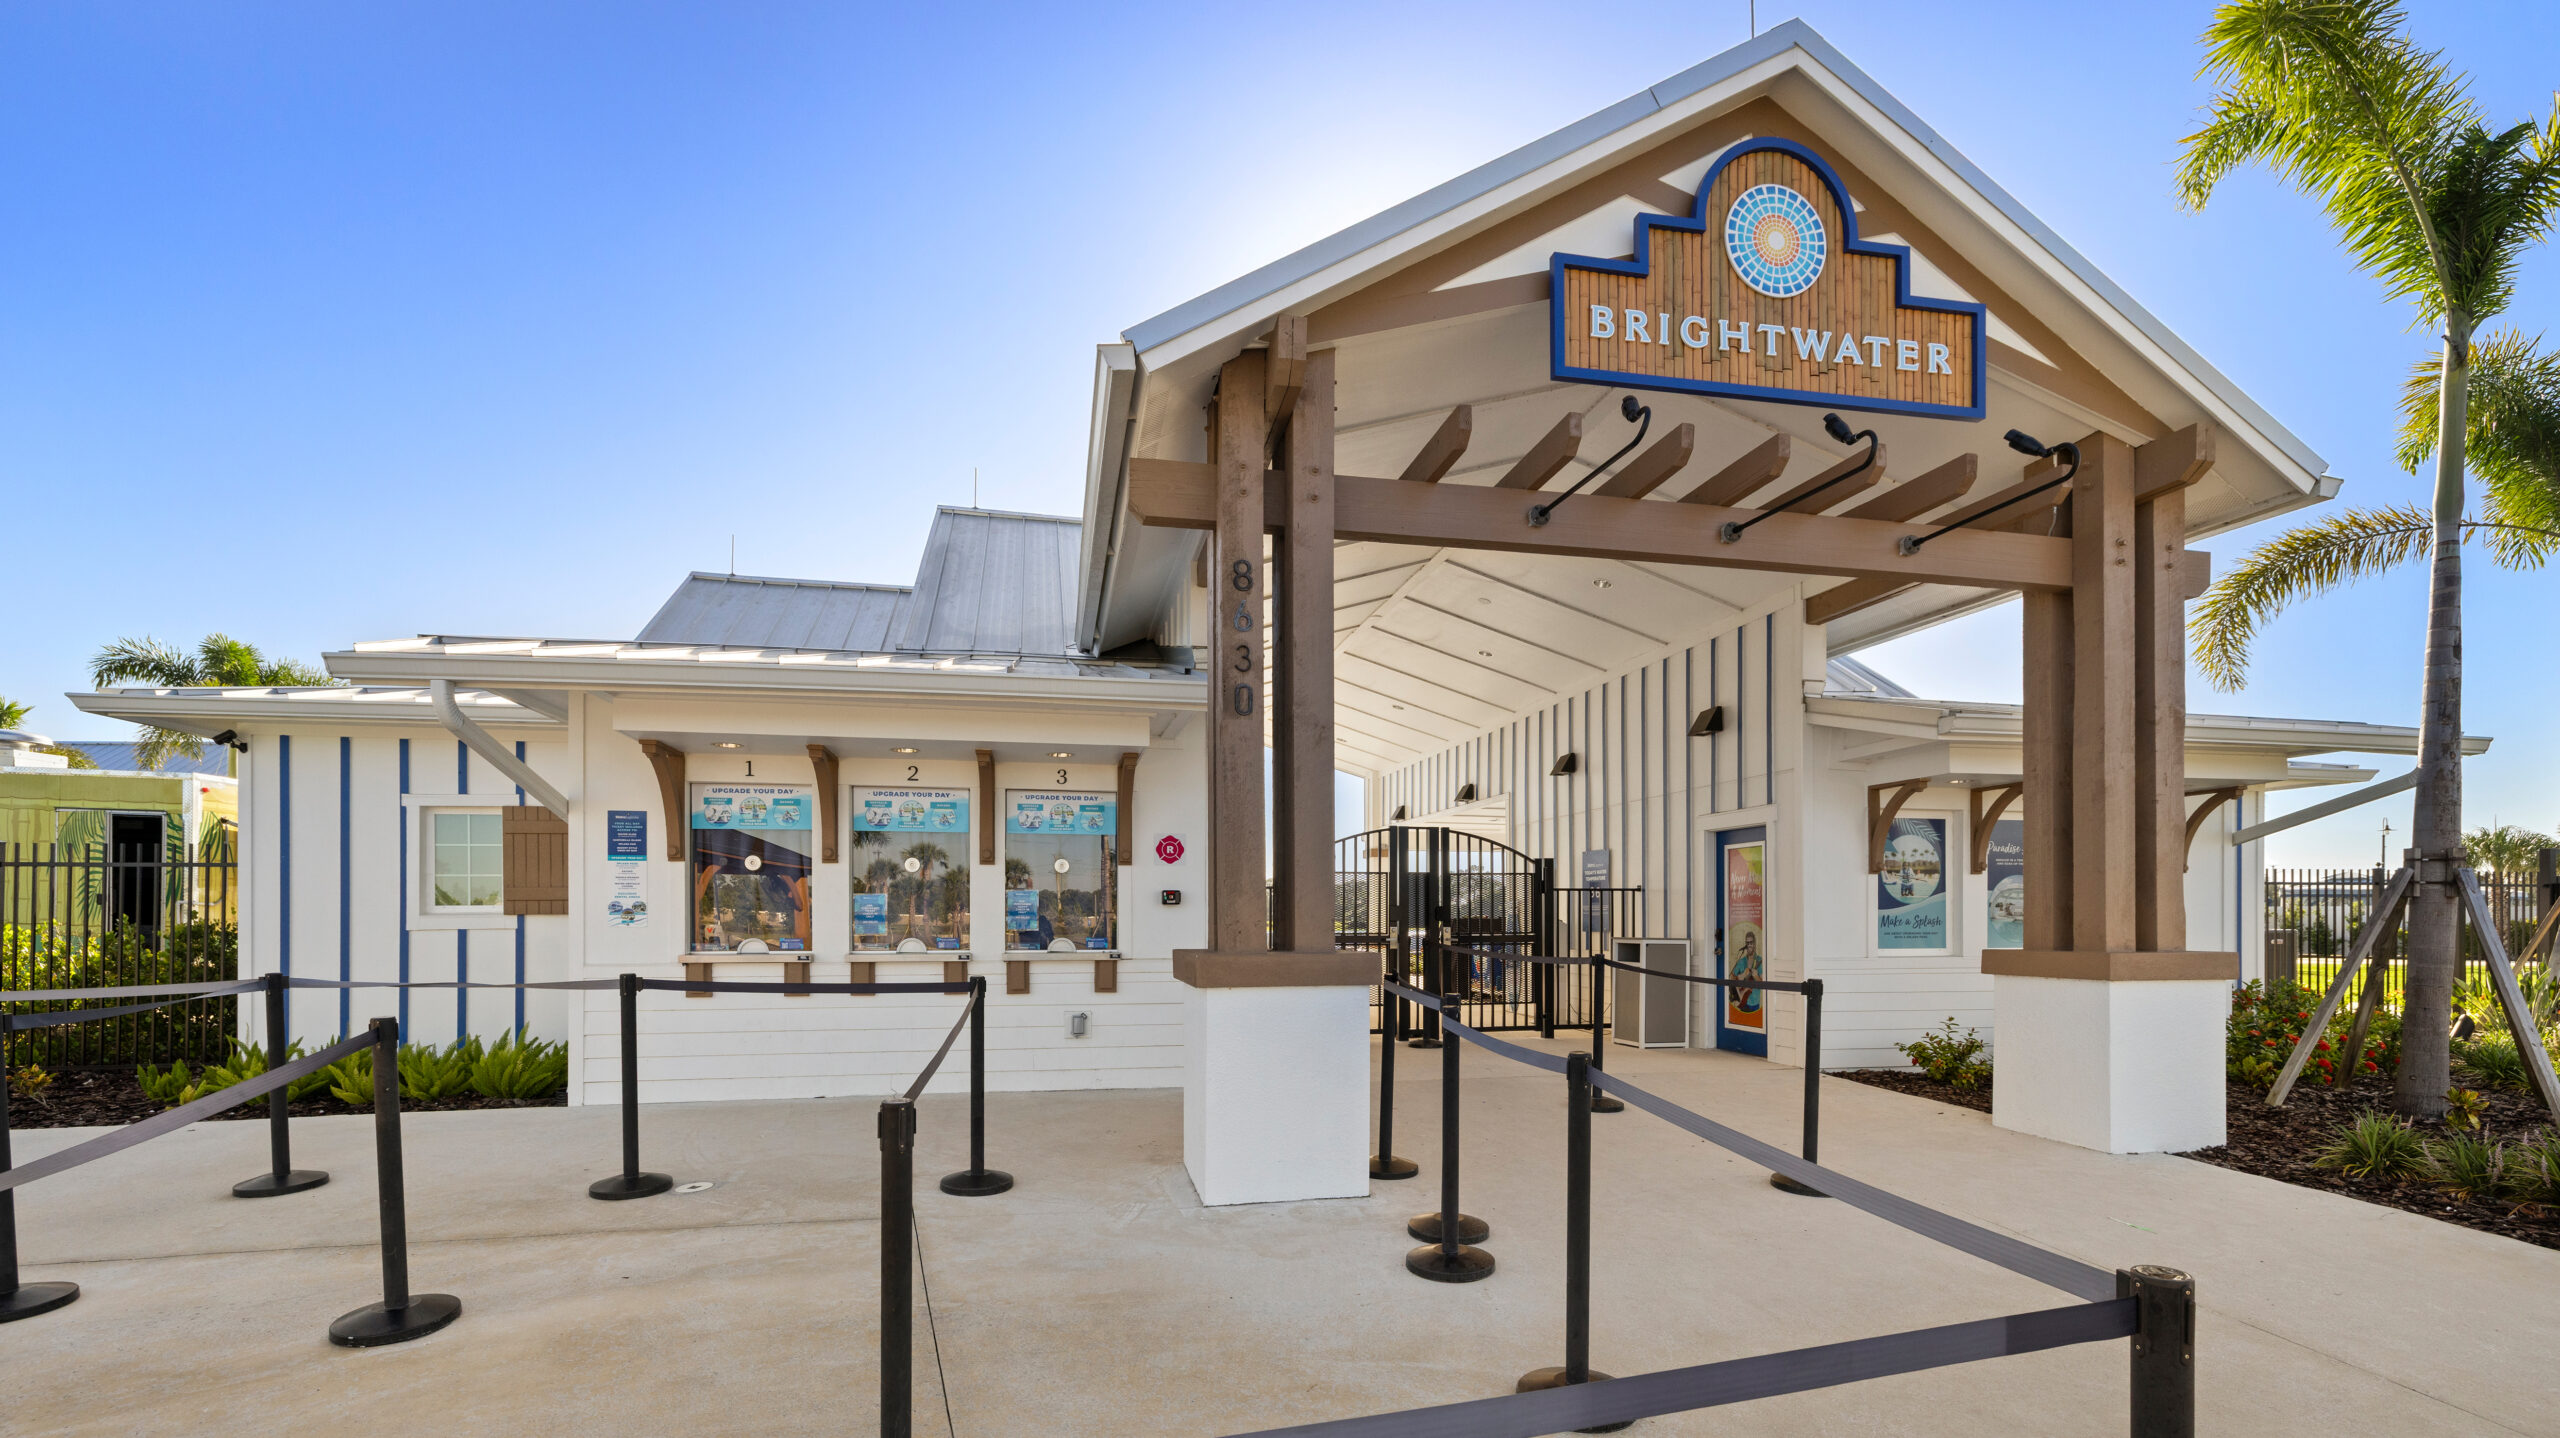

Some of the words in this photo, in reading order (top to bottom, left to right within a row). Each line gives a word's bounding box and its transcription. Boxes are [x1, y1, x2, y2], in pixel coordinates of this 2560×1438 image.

[1590, 304, 1952, 375] BRIGHTWATER
[1233, 559, 1254, 717] 8630
[745, 760, 755, 777] 1
[906, 765, 919, 781] 2
[1056, 768, 1068, 785] 3
[1166, 845, 1174, 854] R
[1987, 840, 2021, 854] Paradise
[1880, 914, 1903, 928] Make
[1905, 918, 1911, 926] a
[1912, 914, 1942, 929] Splash
